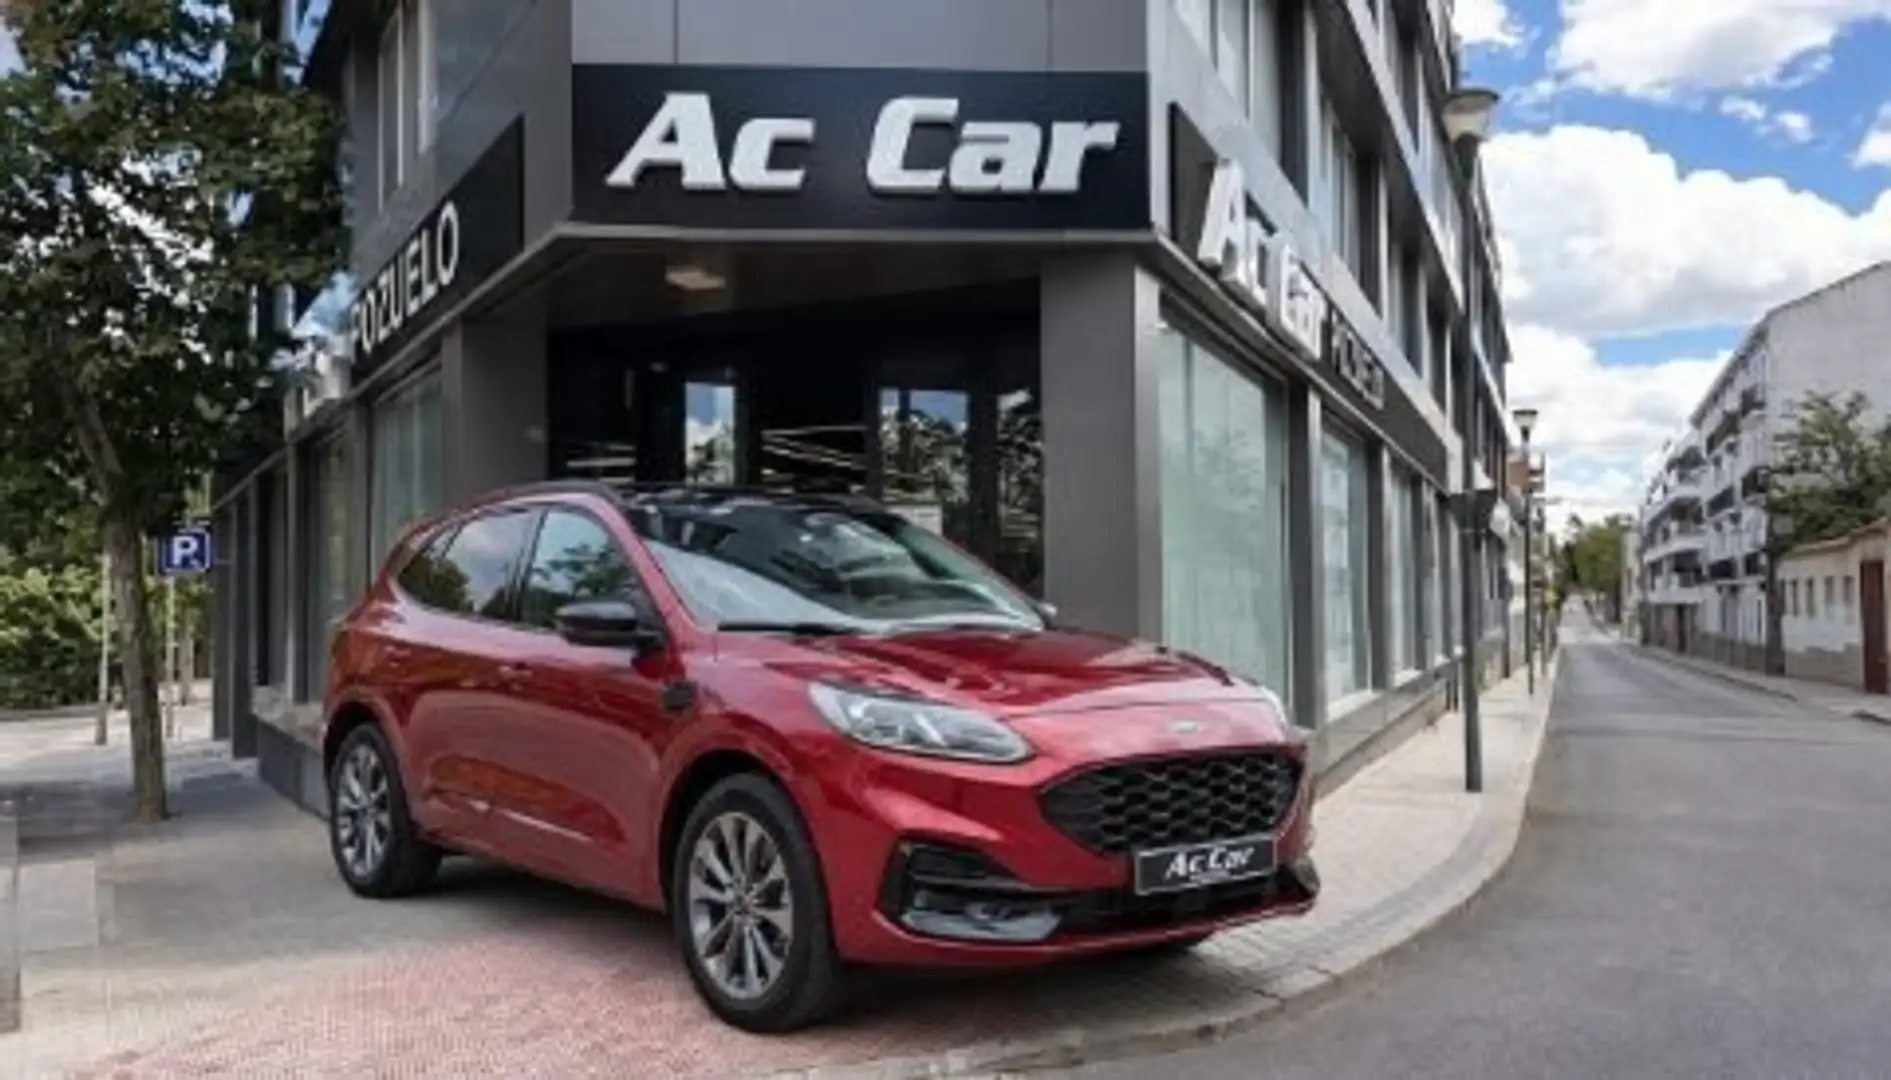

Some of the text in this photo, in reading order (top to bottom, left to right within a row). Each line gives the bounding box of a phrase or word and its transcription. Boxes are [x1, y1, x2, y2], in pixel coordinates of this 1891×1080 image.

[606, 92, 1121, 193] Ac Car
[1164, 851, 1206, 881] Ac
[1208, 847, 1254, 870] Car
